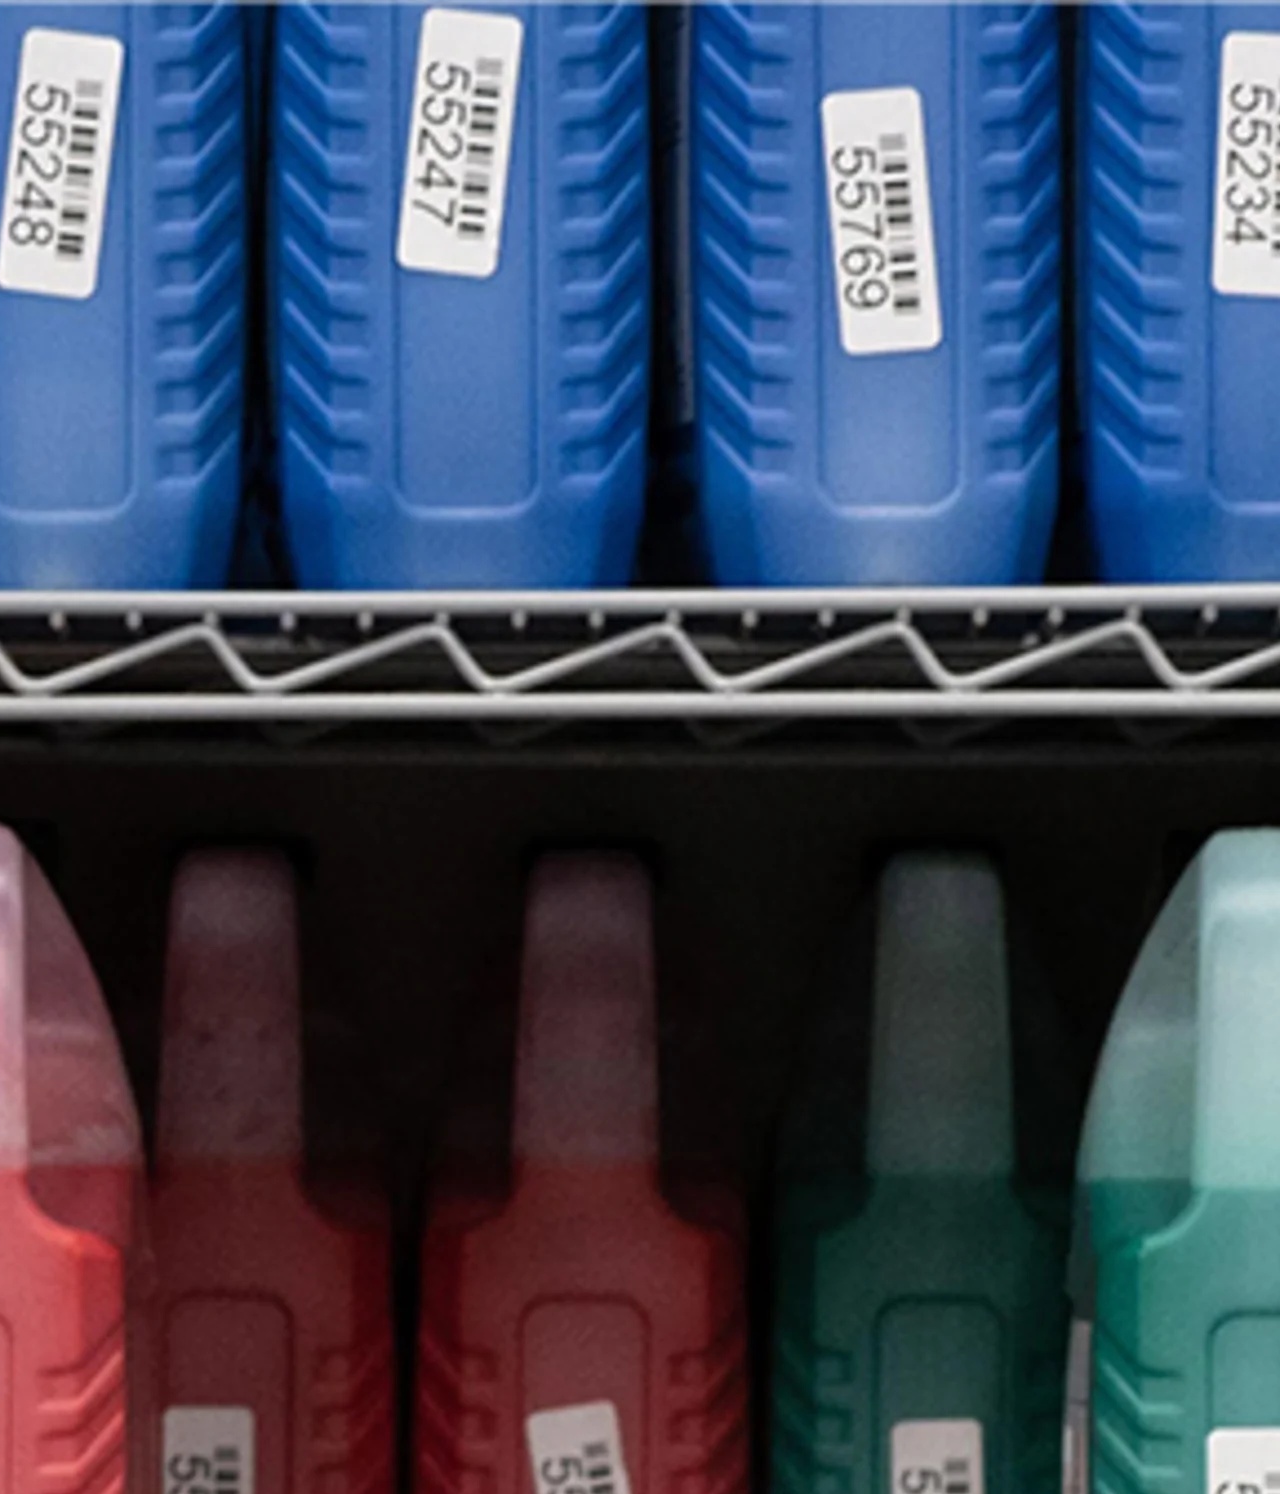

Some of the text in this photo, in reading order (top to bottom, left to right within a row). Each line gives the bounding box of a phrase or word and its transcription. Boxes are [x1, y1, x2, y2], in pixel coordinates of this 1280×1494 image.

[7, 81, 72, 248] 55248
[411, 60, 472, 227] 55247
[1225, 82, 1274, 245] 55234
[832, 145, 888, 310] 55769
